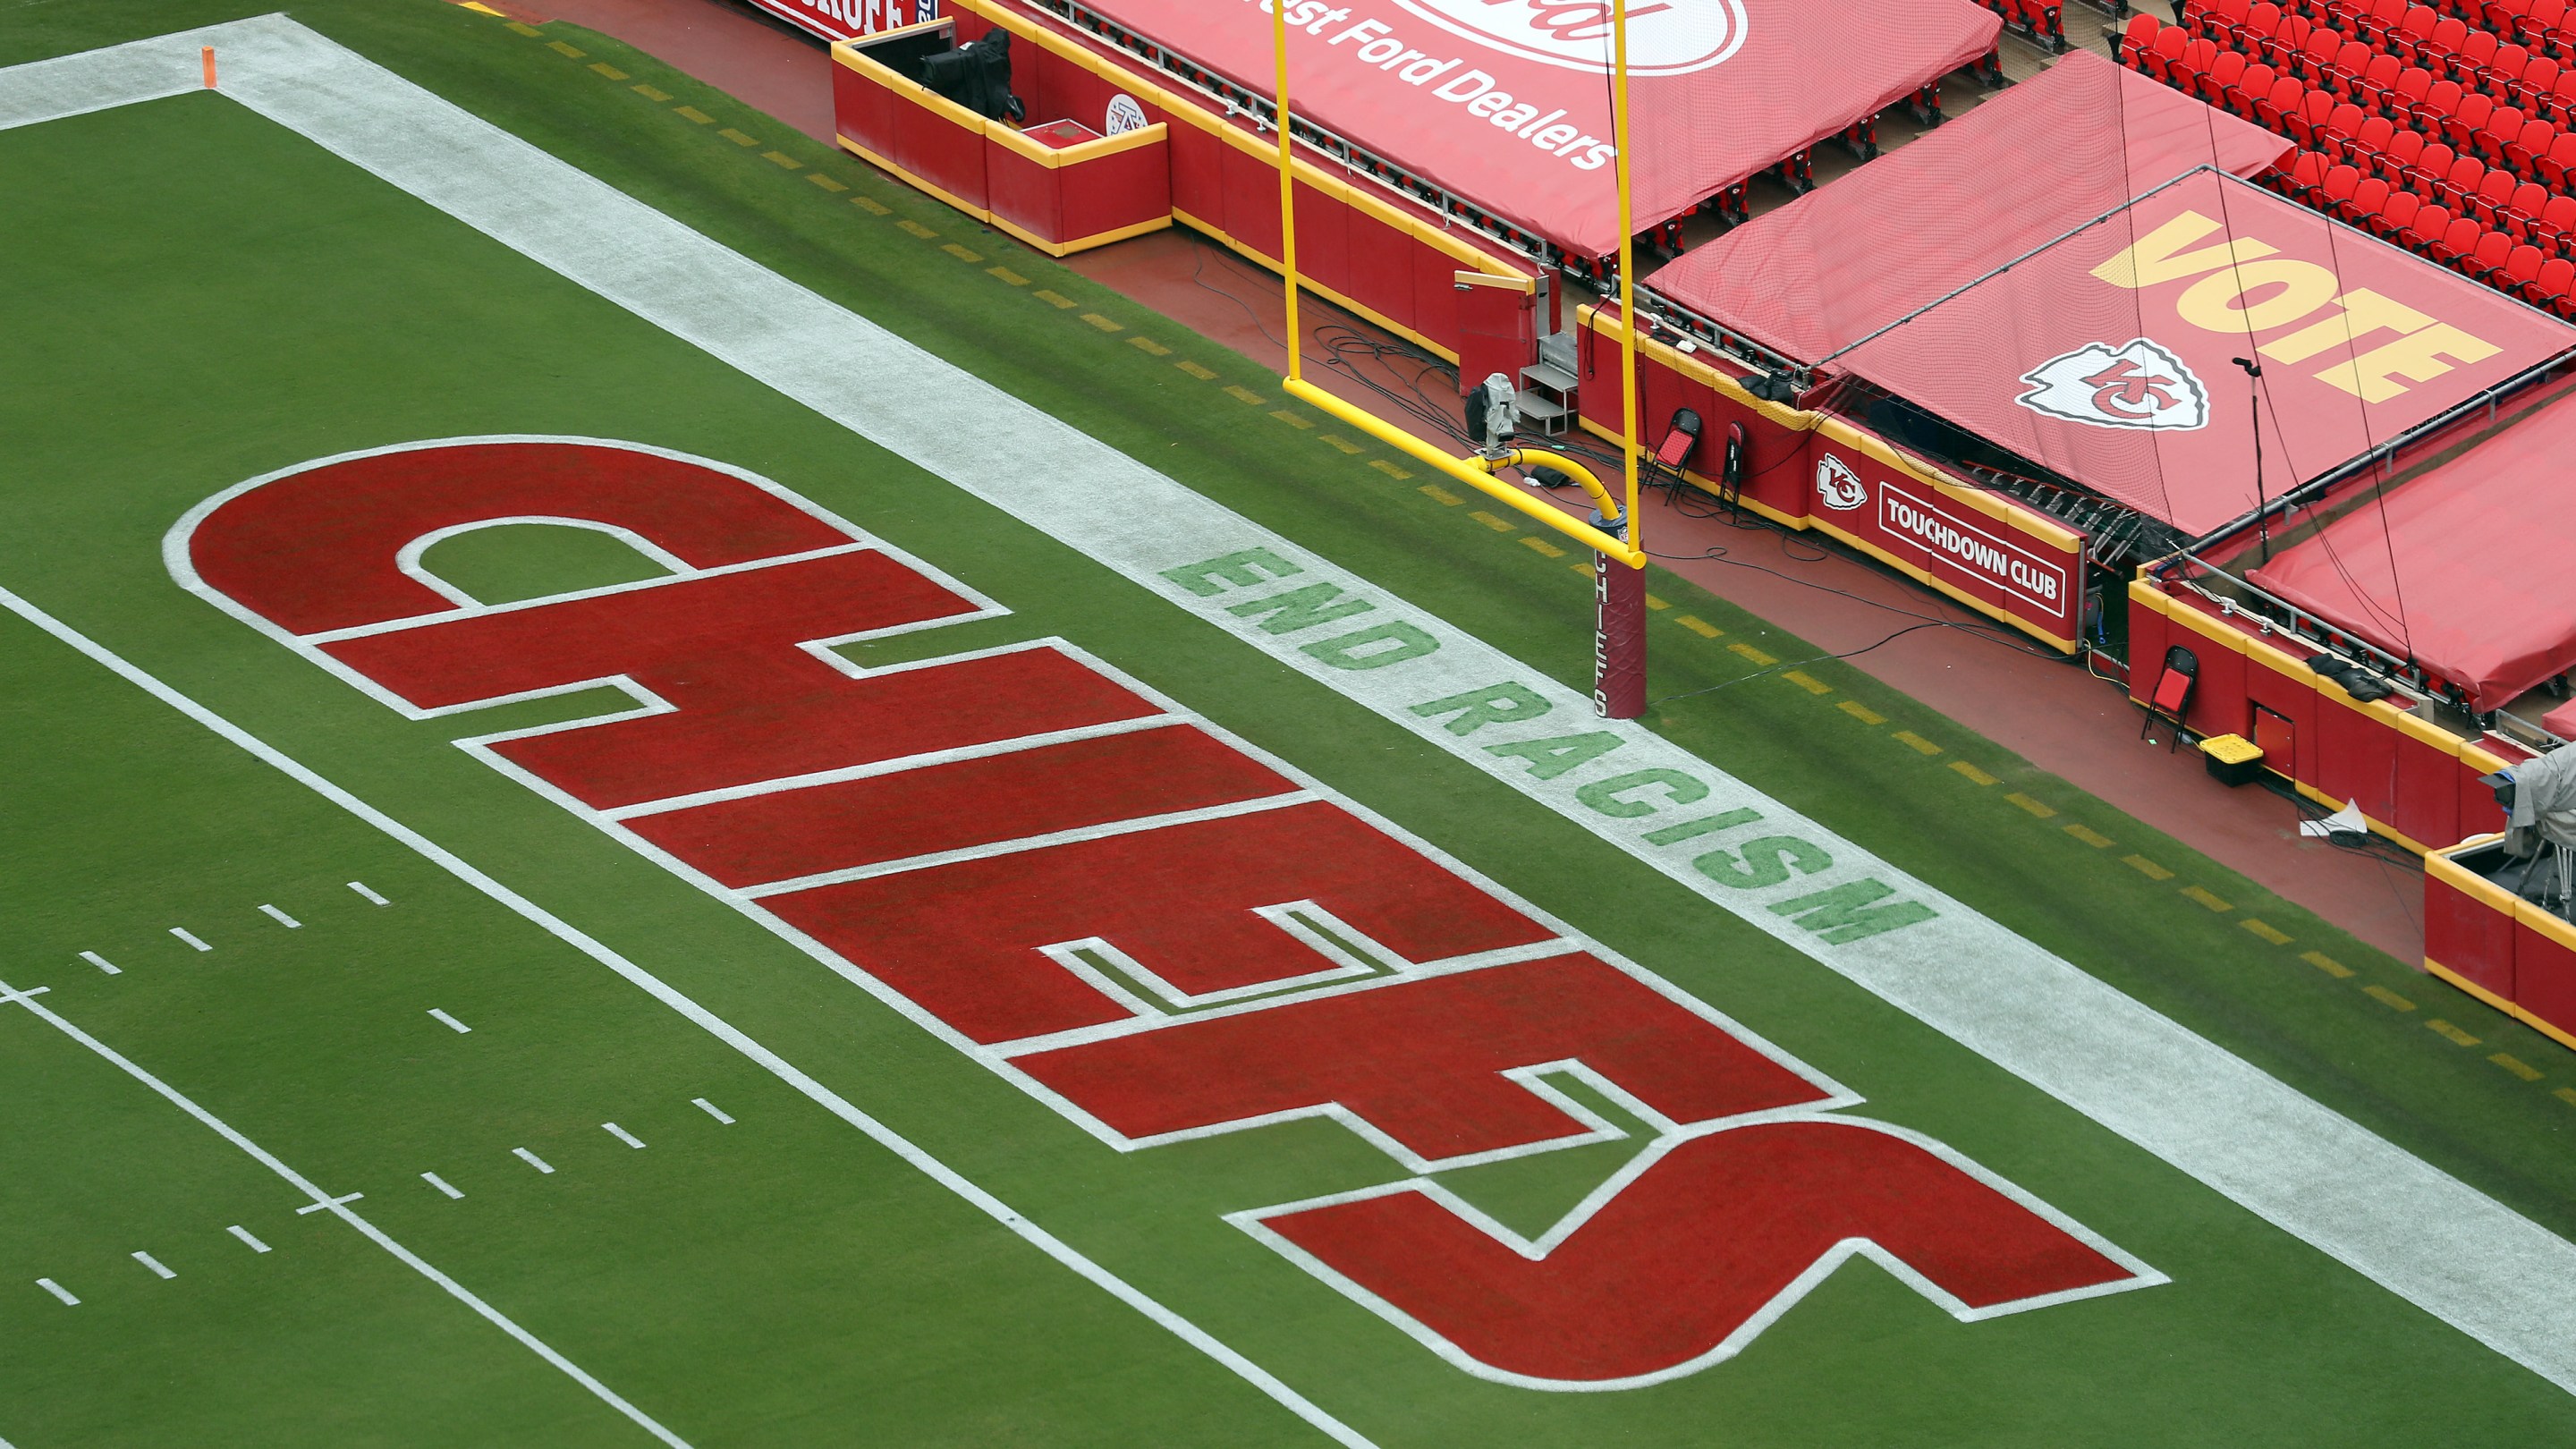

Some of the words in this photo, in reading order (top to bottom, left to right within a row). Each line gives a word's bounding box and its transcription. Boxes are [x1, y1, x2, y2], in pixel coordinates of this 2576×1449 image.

[1326, 18, 1464, 86] Ford
[1431, 69, 1618, 171] Dealers
[2088, 209, 2504, 404] VOTE
[1594, 548, 1608, 717] CHIEFS
[1886, 497, 2007, 576] TOUCHDOWN
[2010, 560, 2057, 600] CLUB
[1159, 547, 1441, 671] END
[1411, 681, 1940, 946] RACISM
[162, 434, 2171, 1392] CHIEFS
